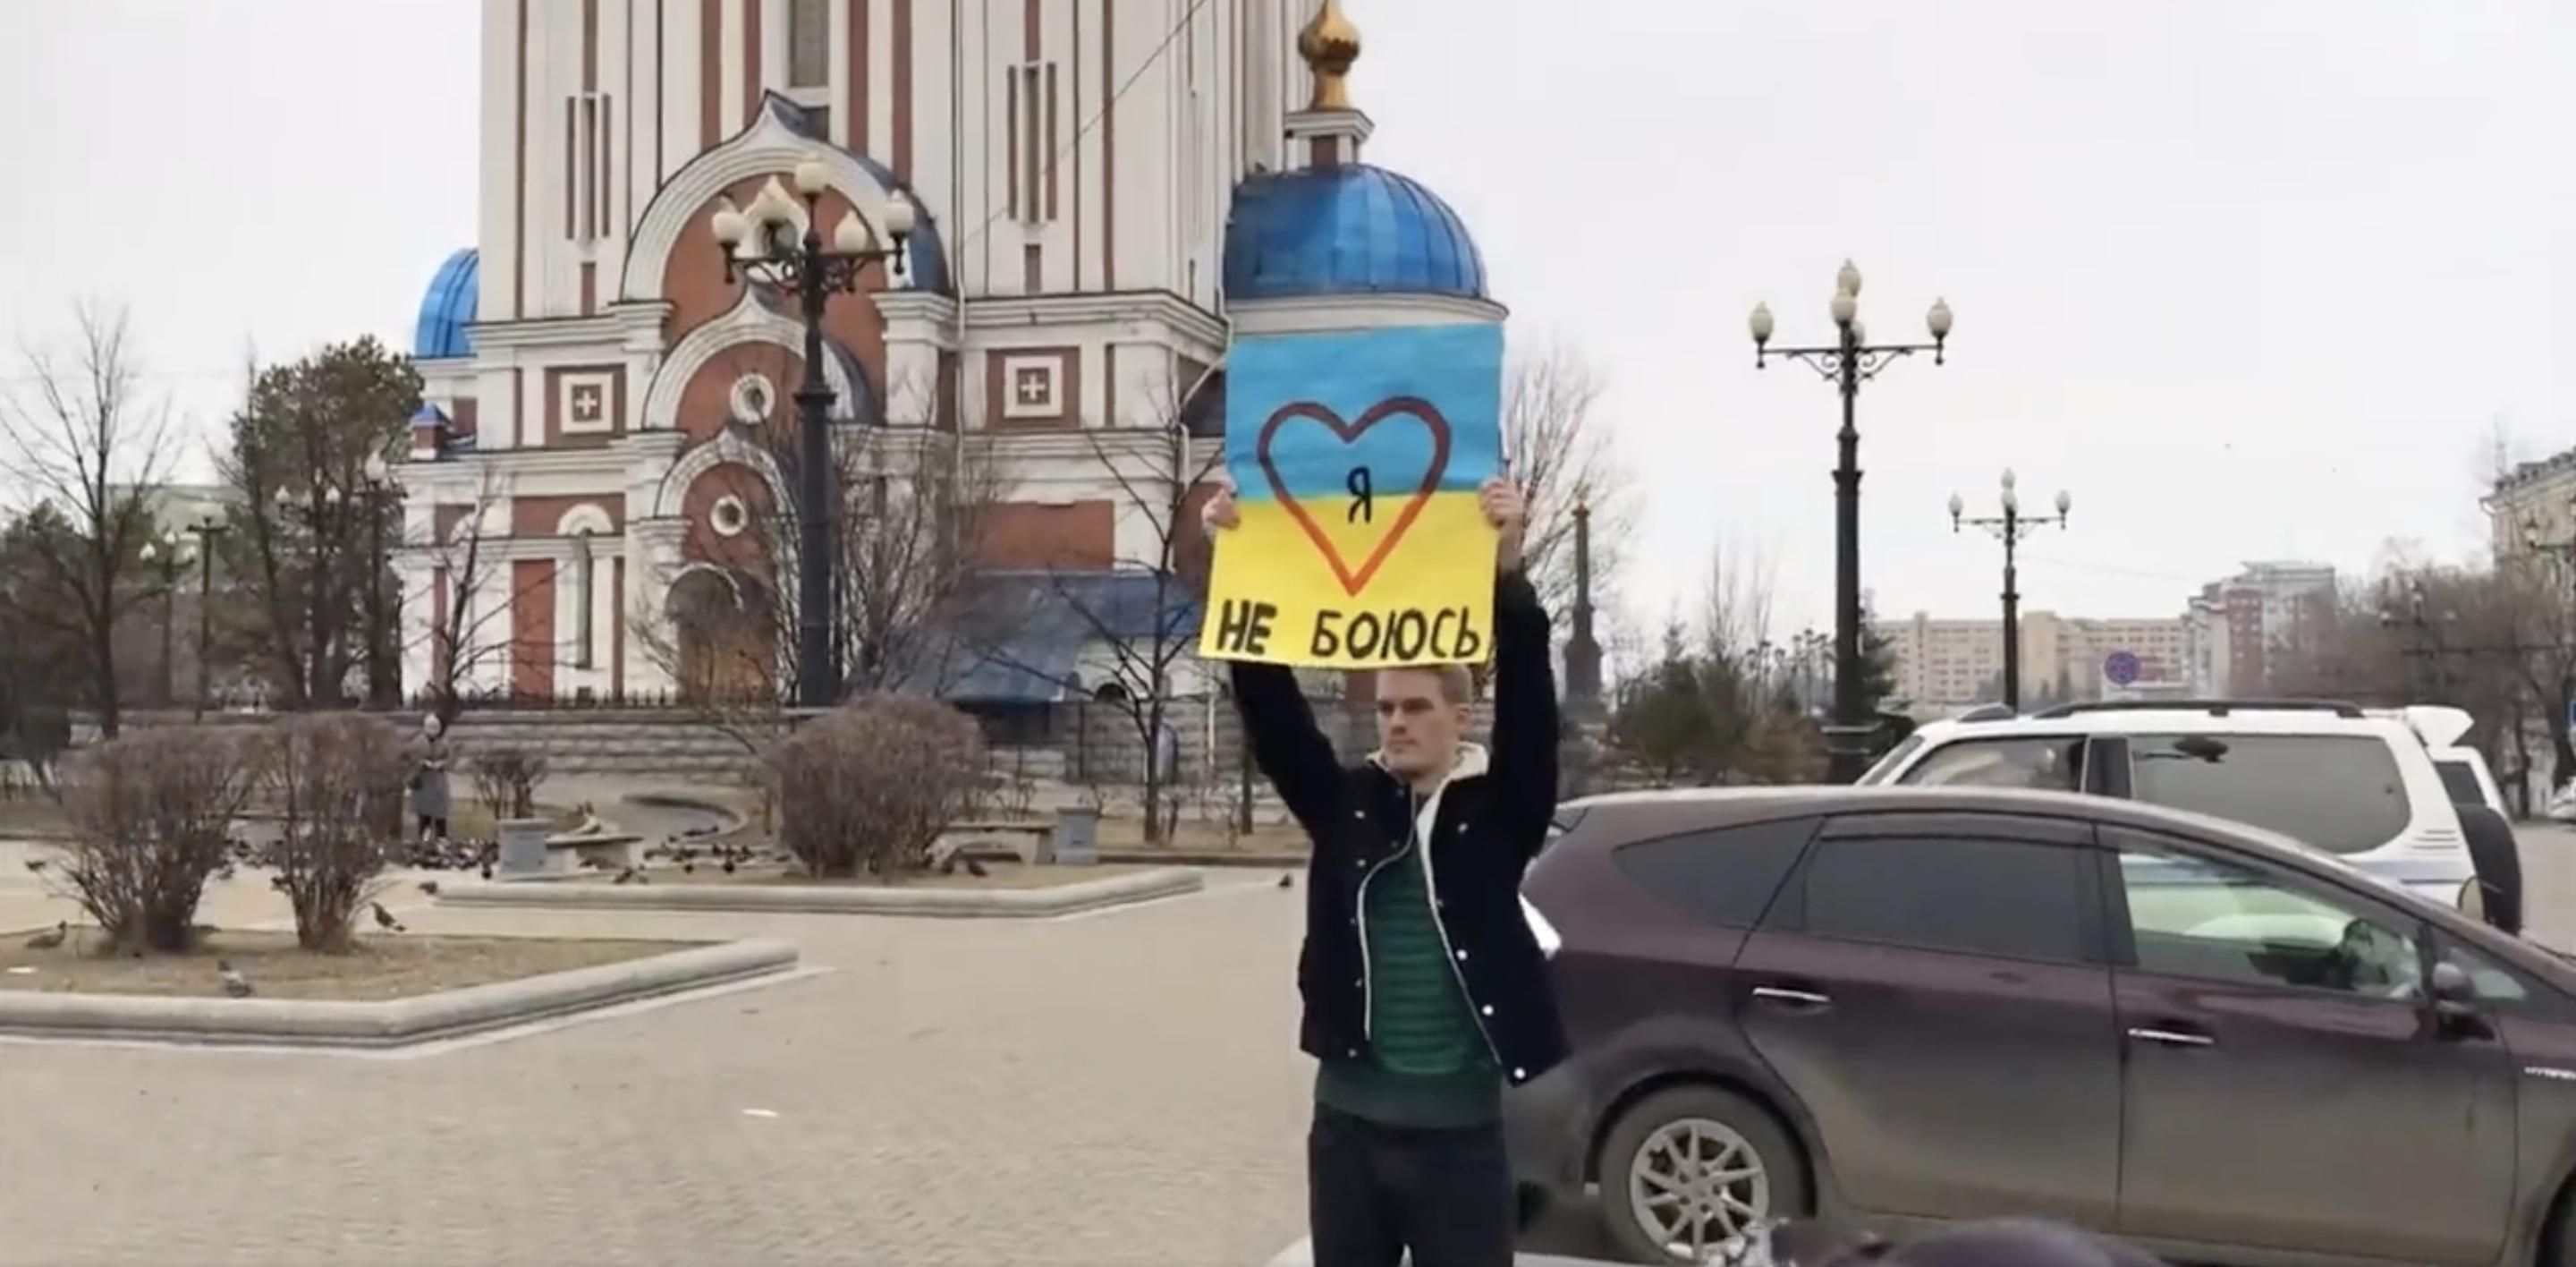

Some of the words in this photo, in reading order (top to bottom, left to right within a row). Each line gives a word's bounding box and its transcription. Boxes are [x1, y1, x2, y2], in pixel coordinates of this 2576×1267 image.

[1347, 466, 1371, 523] Я
[1216, 599, 1277, 655] НЕ
[1310, 606, 1481, 659] БОЮСЬ
